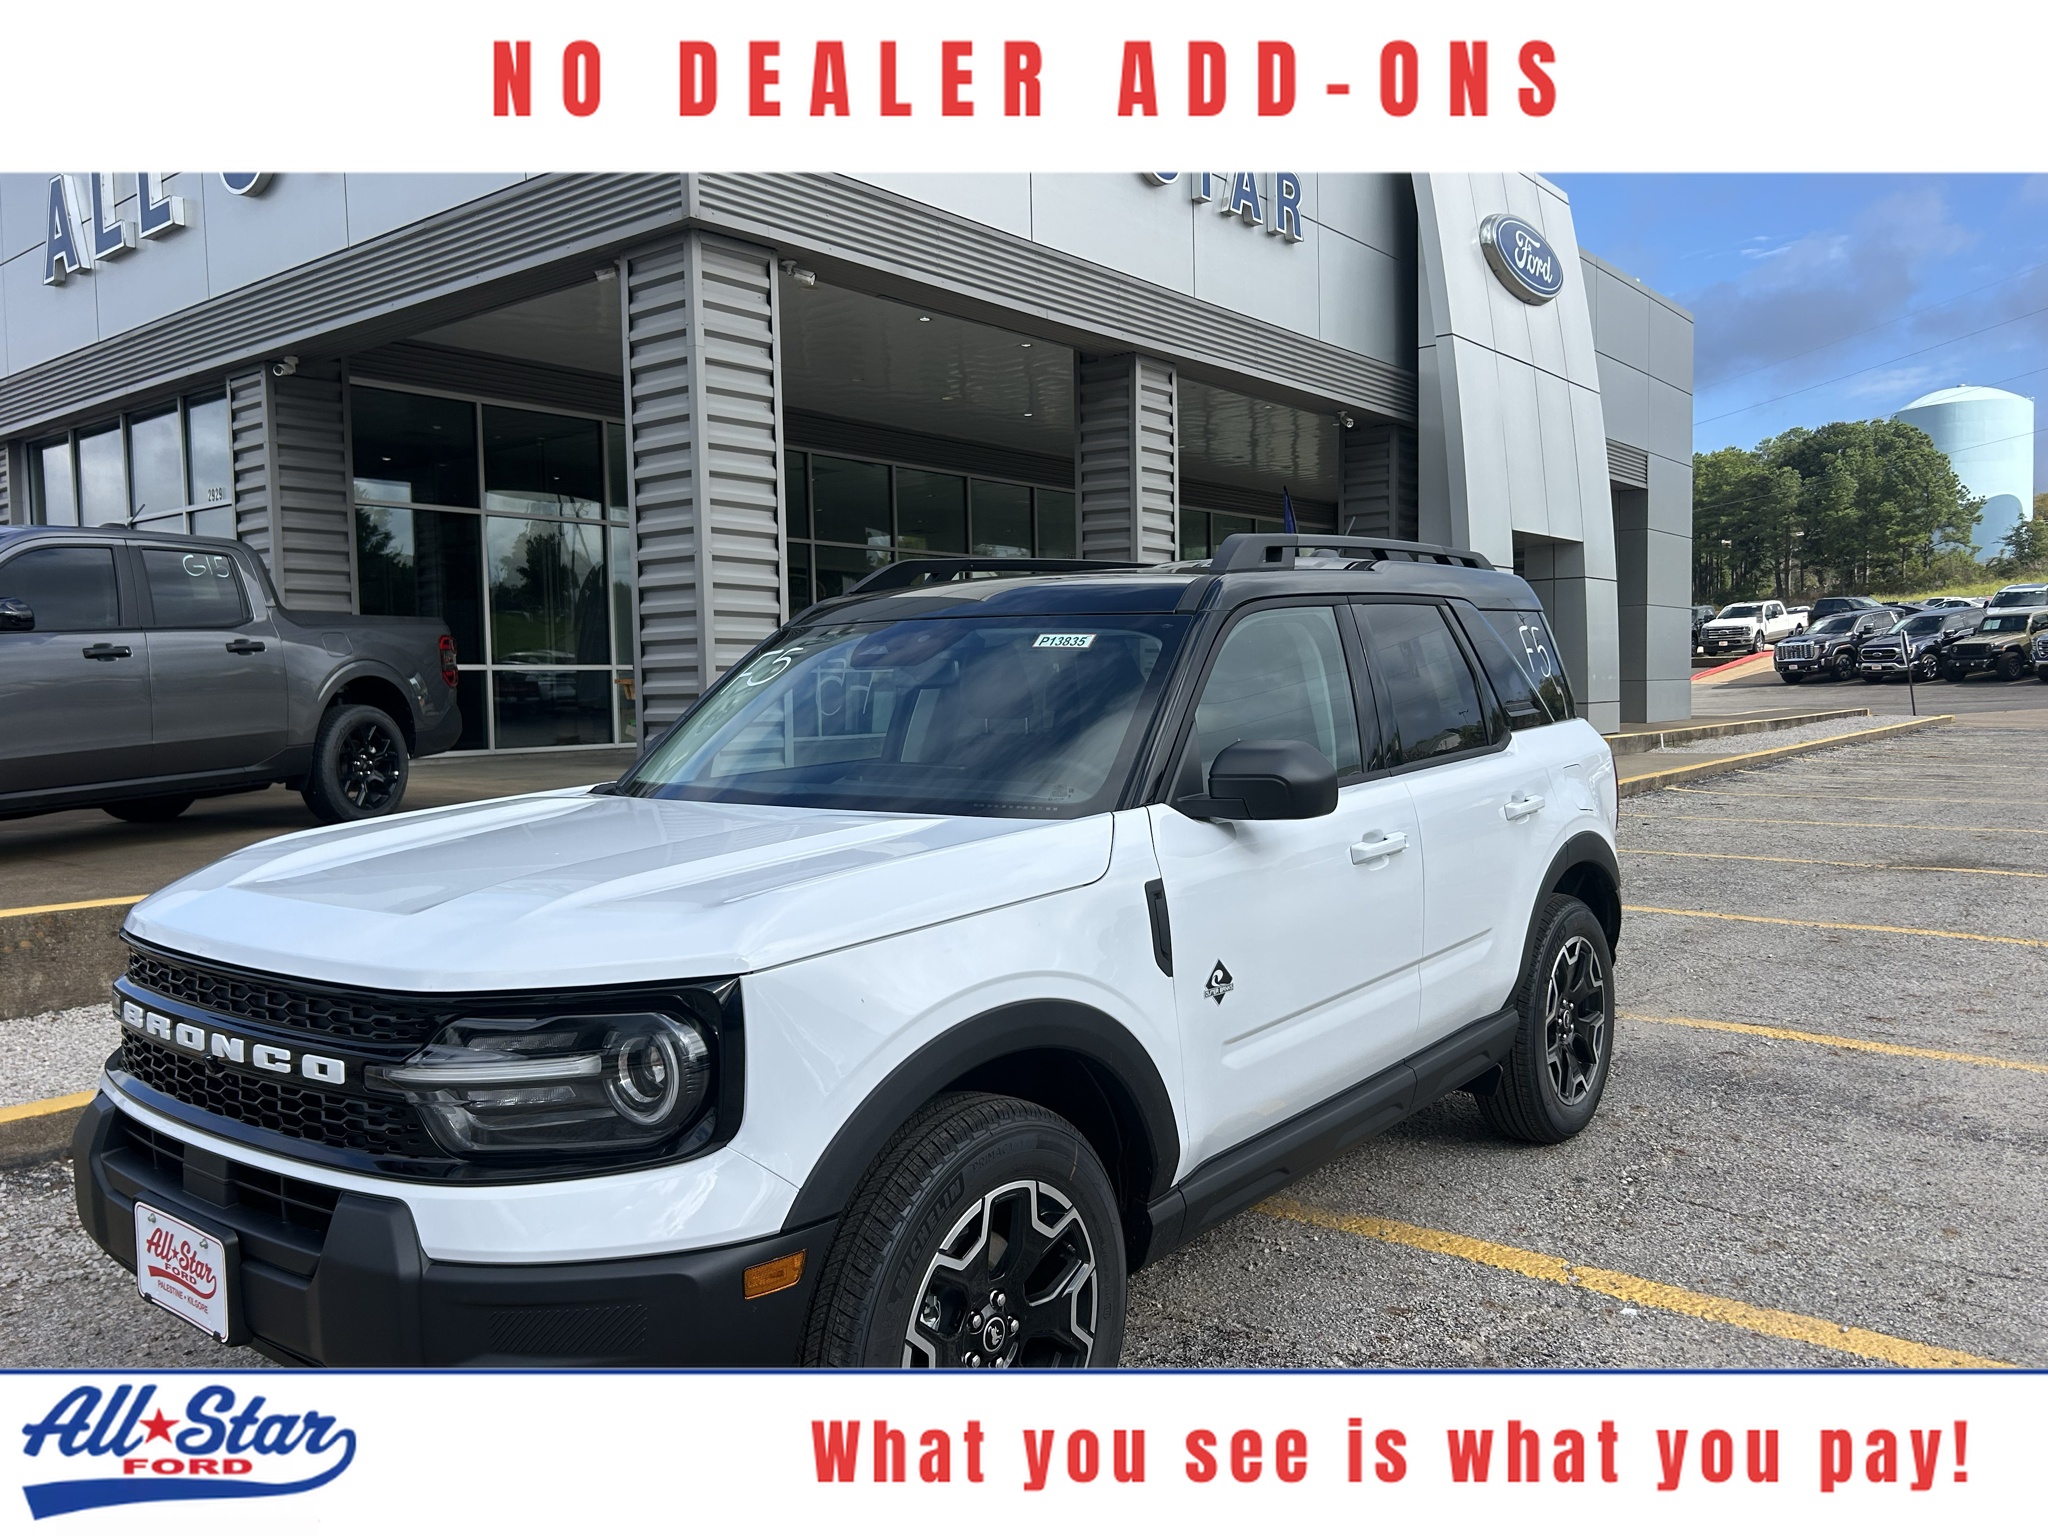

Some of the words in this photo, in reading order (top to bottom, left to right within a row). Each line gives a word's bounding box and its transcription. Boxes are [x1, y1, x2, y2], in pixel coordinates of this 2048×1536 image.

[43, 172, 185, 286] ALL
[1513, 230, 1553, 284] Ford
[182, 554, 230, 578] G15
[1038, 636, 1088, 647] P13835
[1518, 625, 1552, 678] F5
[719, 647, 804, 695] F5
[123, 1000, 346, 1085] BRONCO
[895, 1176, 963, 1291] MICHELIN
[157, 1279, 183, 1300] PALESTINE
[187, 1295, 209, 1315] KILGORE
[164, 1262, 197, 1285] FORD
